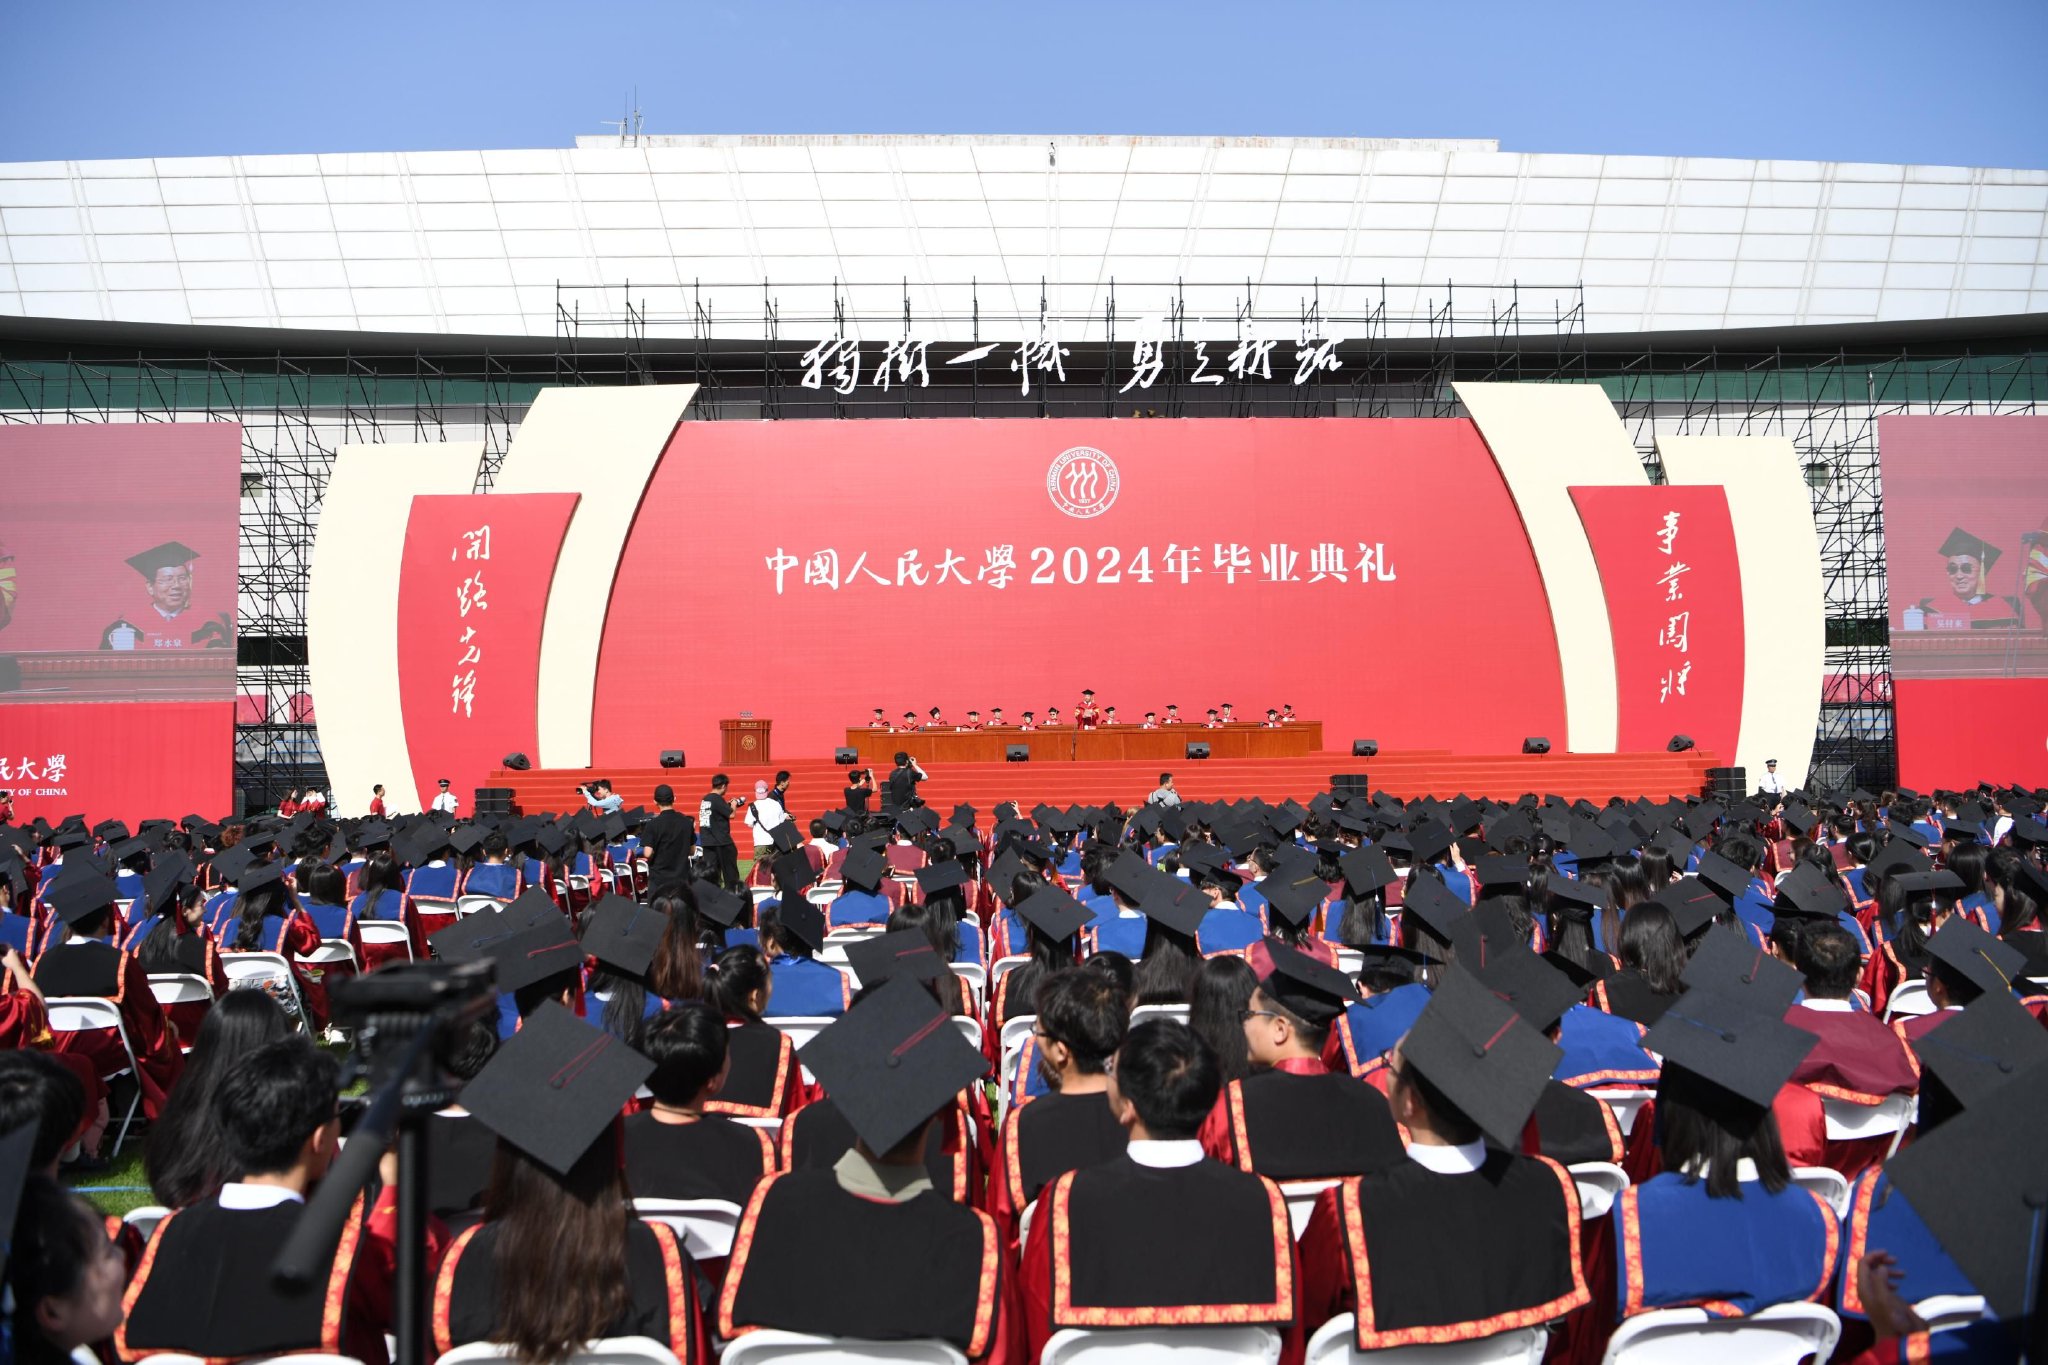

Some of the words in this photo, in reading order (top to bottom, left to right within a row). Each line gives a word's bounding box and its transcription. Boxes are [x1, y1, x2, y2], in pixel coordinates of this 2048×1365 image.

[1059, 450, 1102, 465] UNIVERSITY
[1102, 459, 1111, 469] OF
[1108, 469, 1117, 492] CHINA
[18, 788, 32, 797] OF
[35, 788, 68, 796] CHINA
